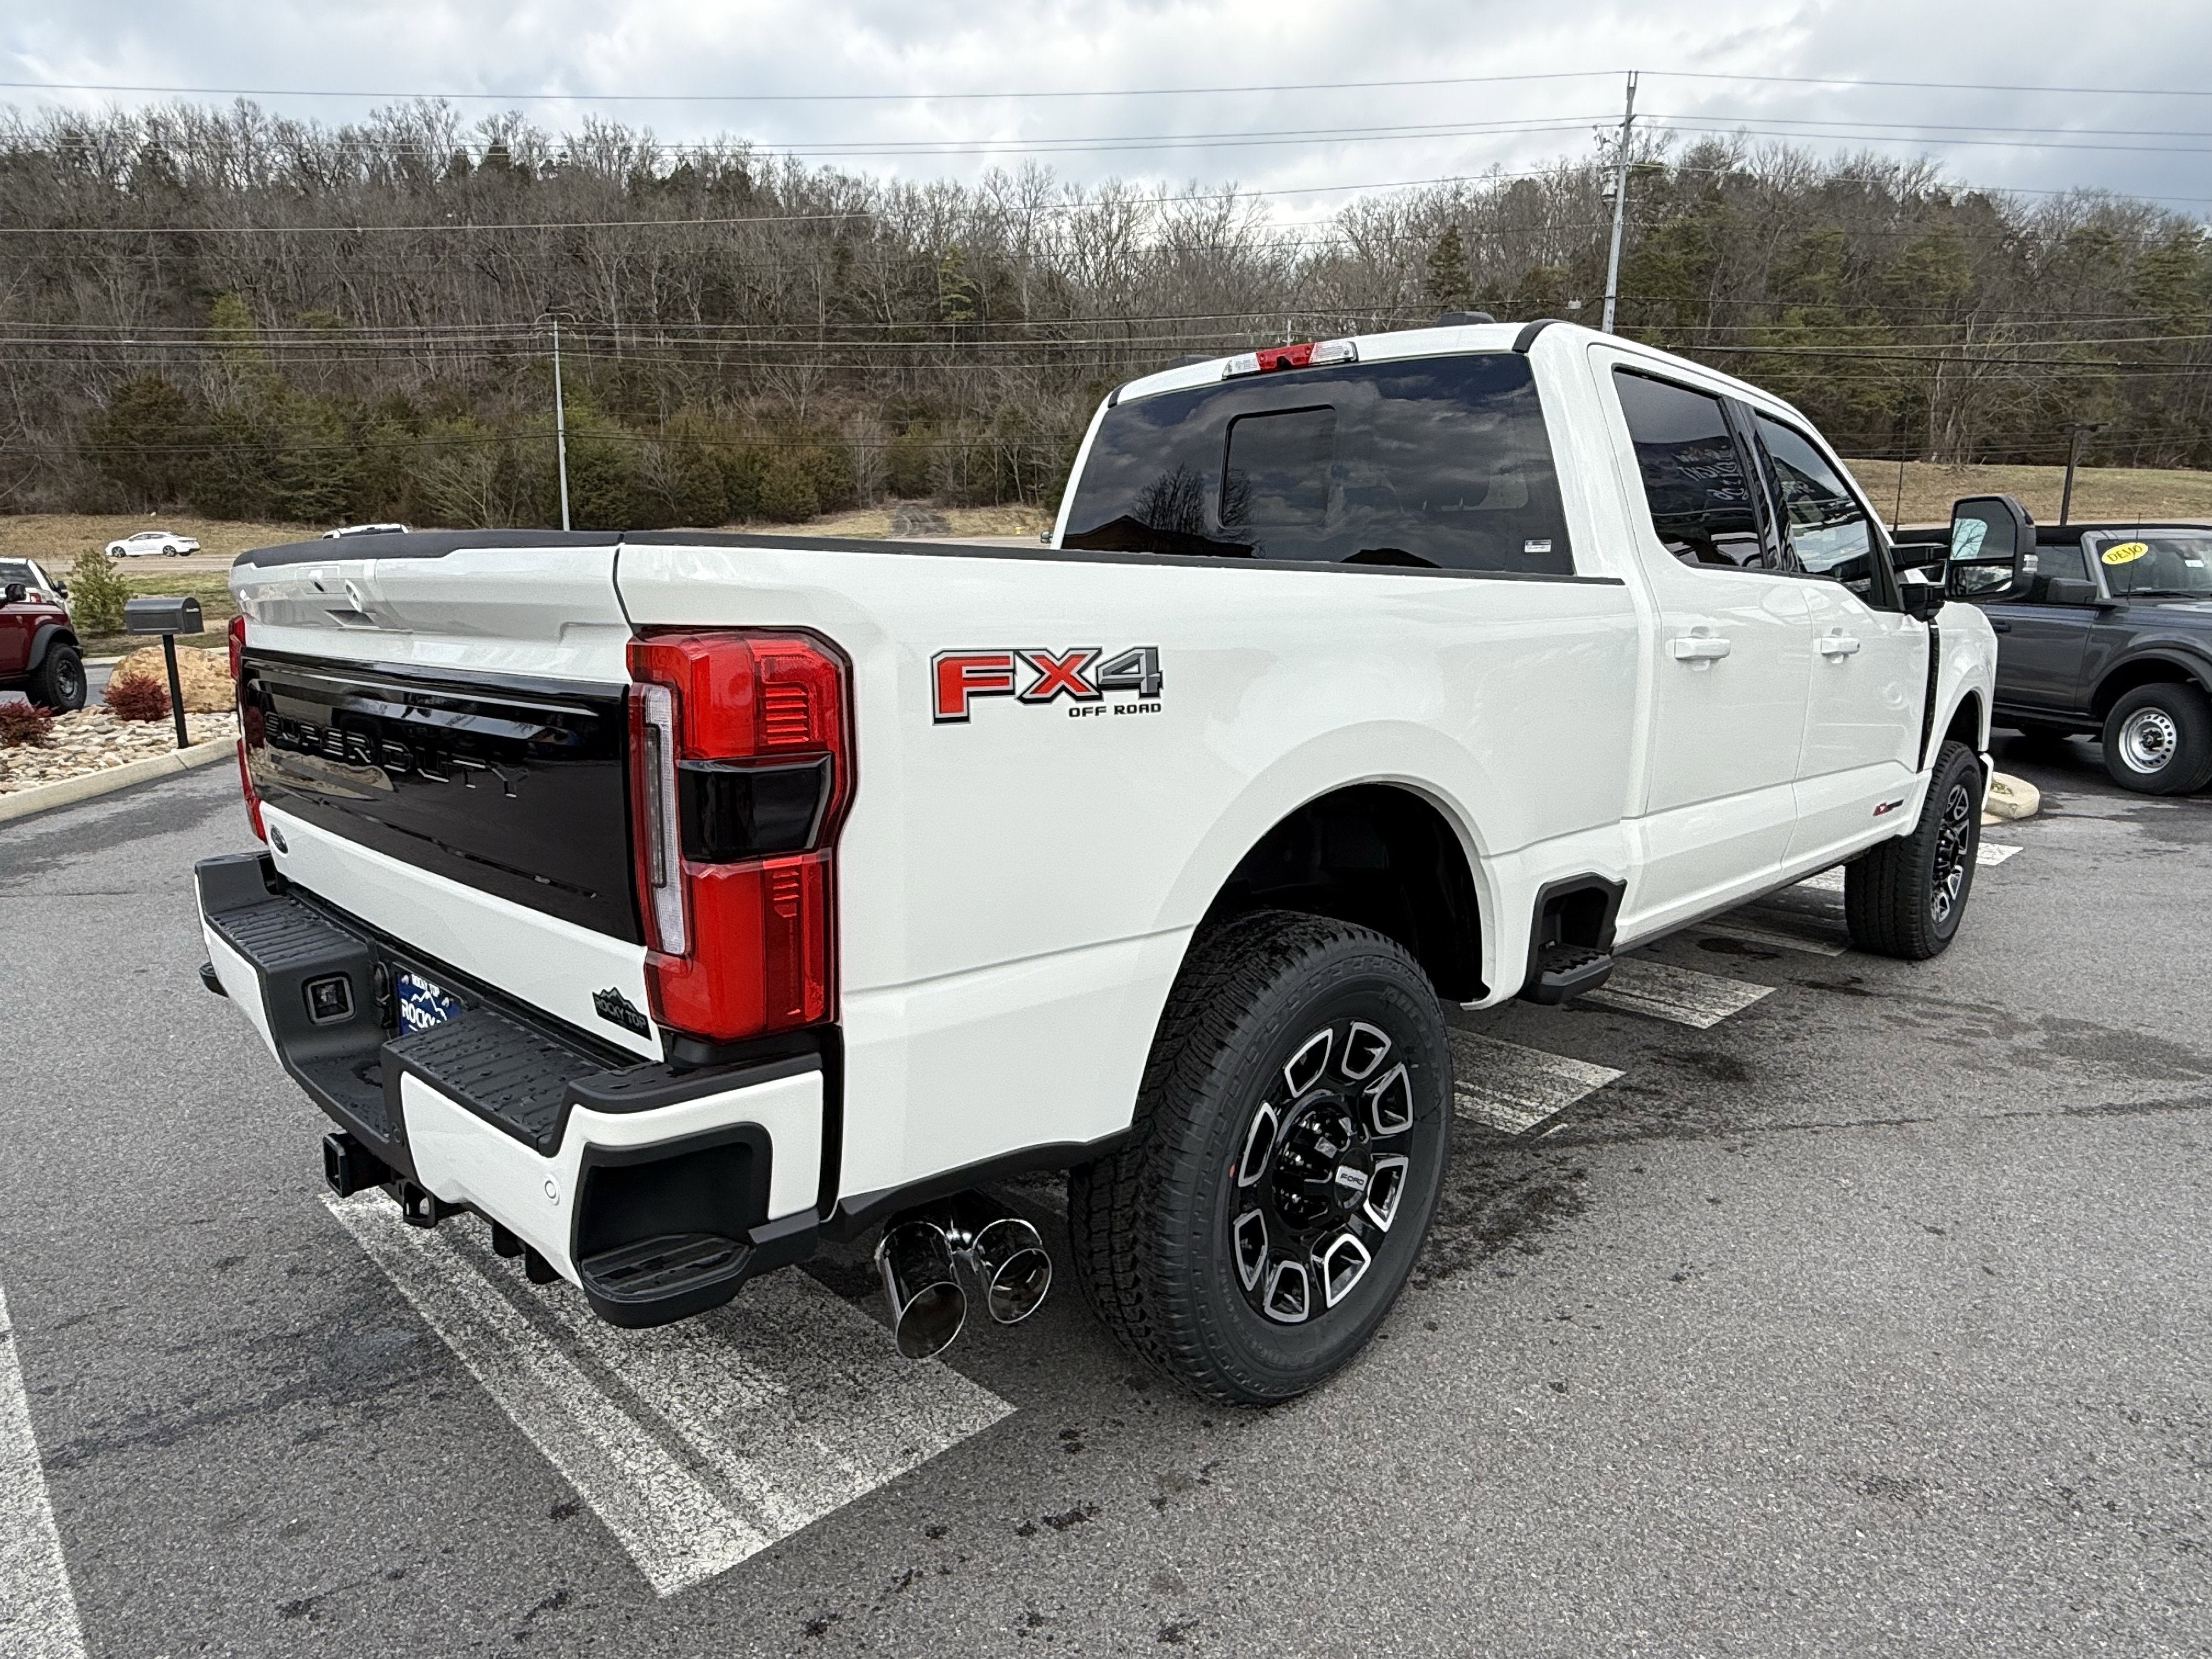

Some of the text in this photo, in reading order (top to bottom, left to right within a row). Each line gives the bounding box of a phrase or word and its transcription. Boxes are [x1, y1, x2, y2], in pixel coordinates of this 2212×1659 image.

[2107, 544, 2143, 562] DEMO
[930, 645, 1163, 726] FX4
[1069, 703, 1162, 718] OFF ROAD
[265, 711, 529, 799] SUPER DUTY
[594, 996, 646, 1029] ROCKY TOP
[1340, 1173, 1364, 1186] FORD
